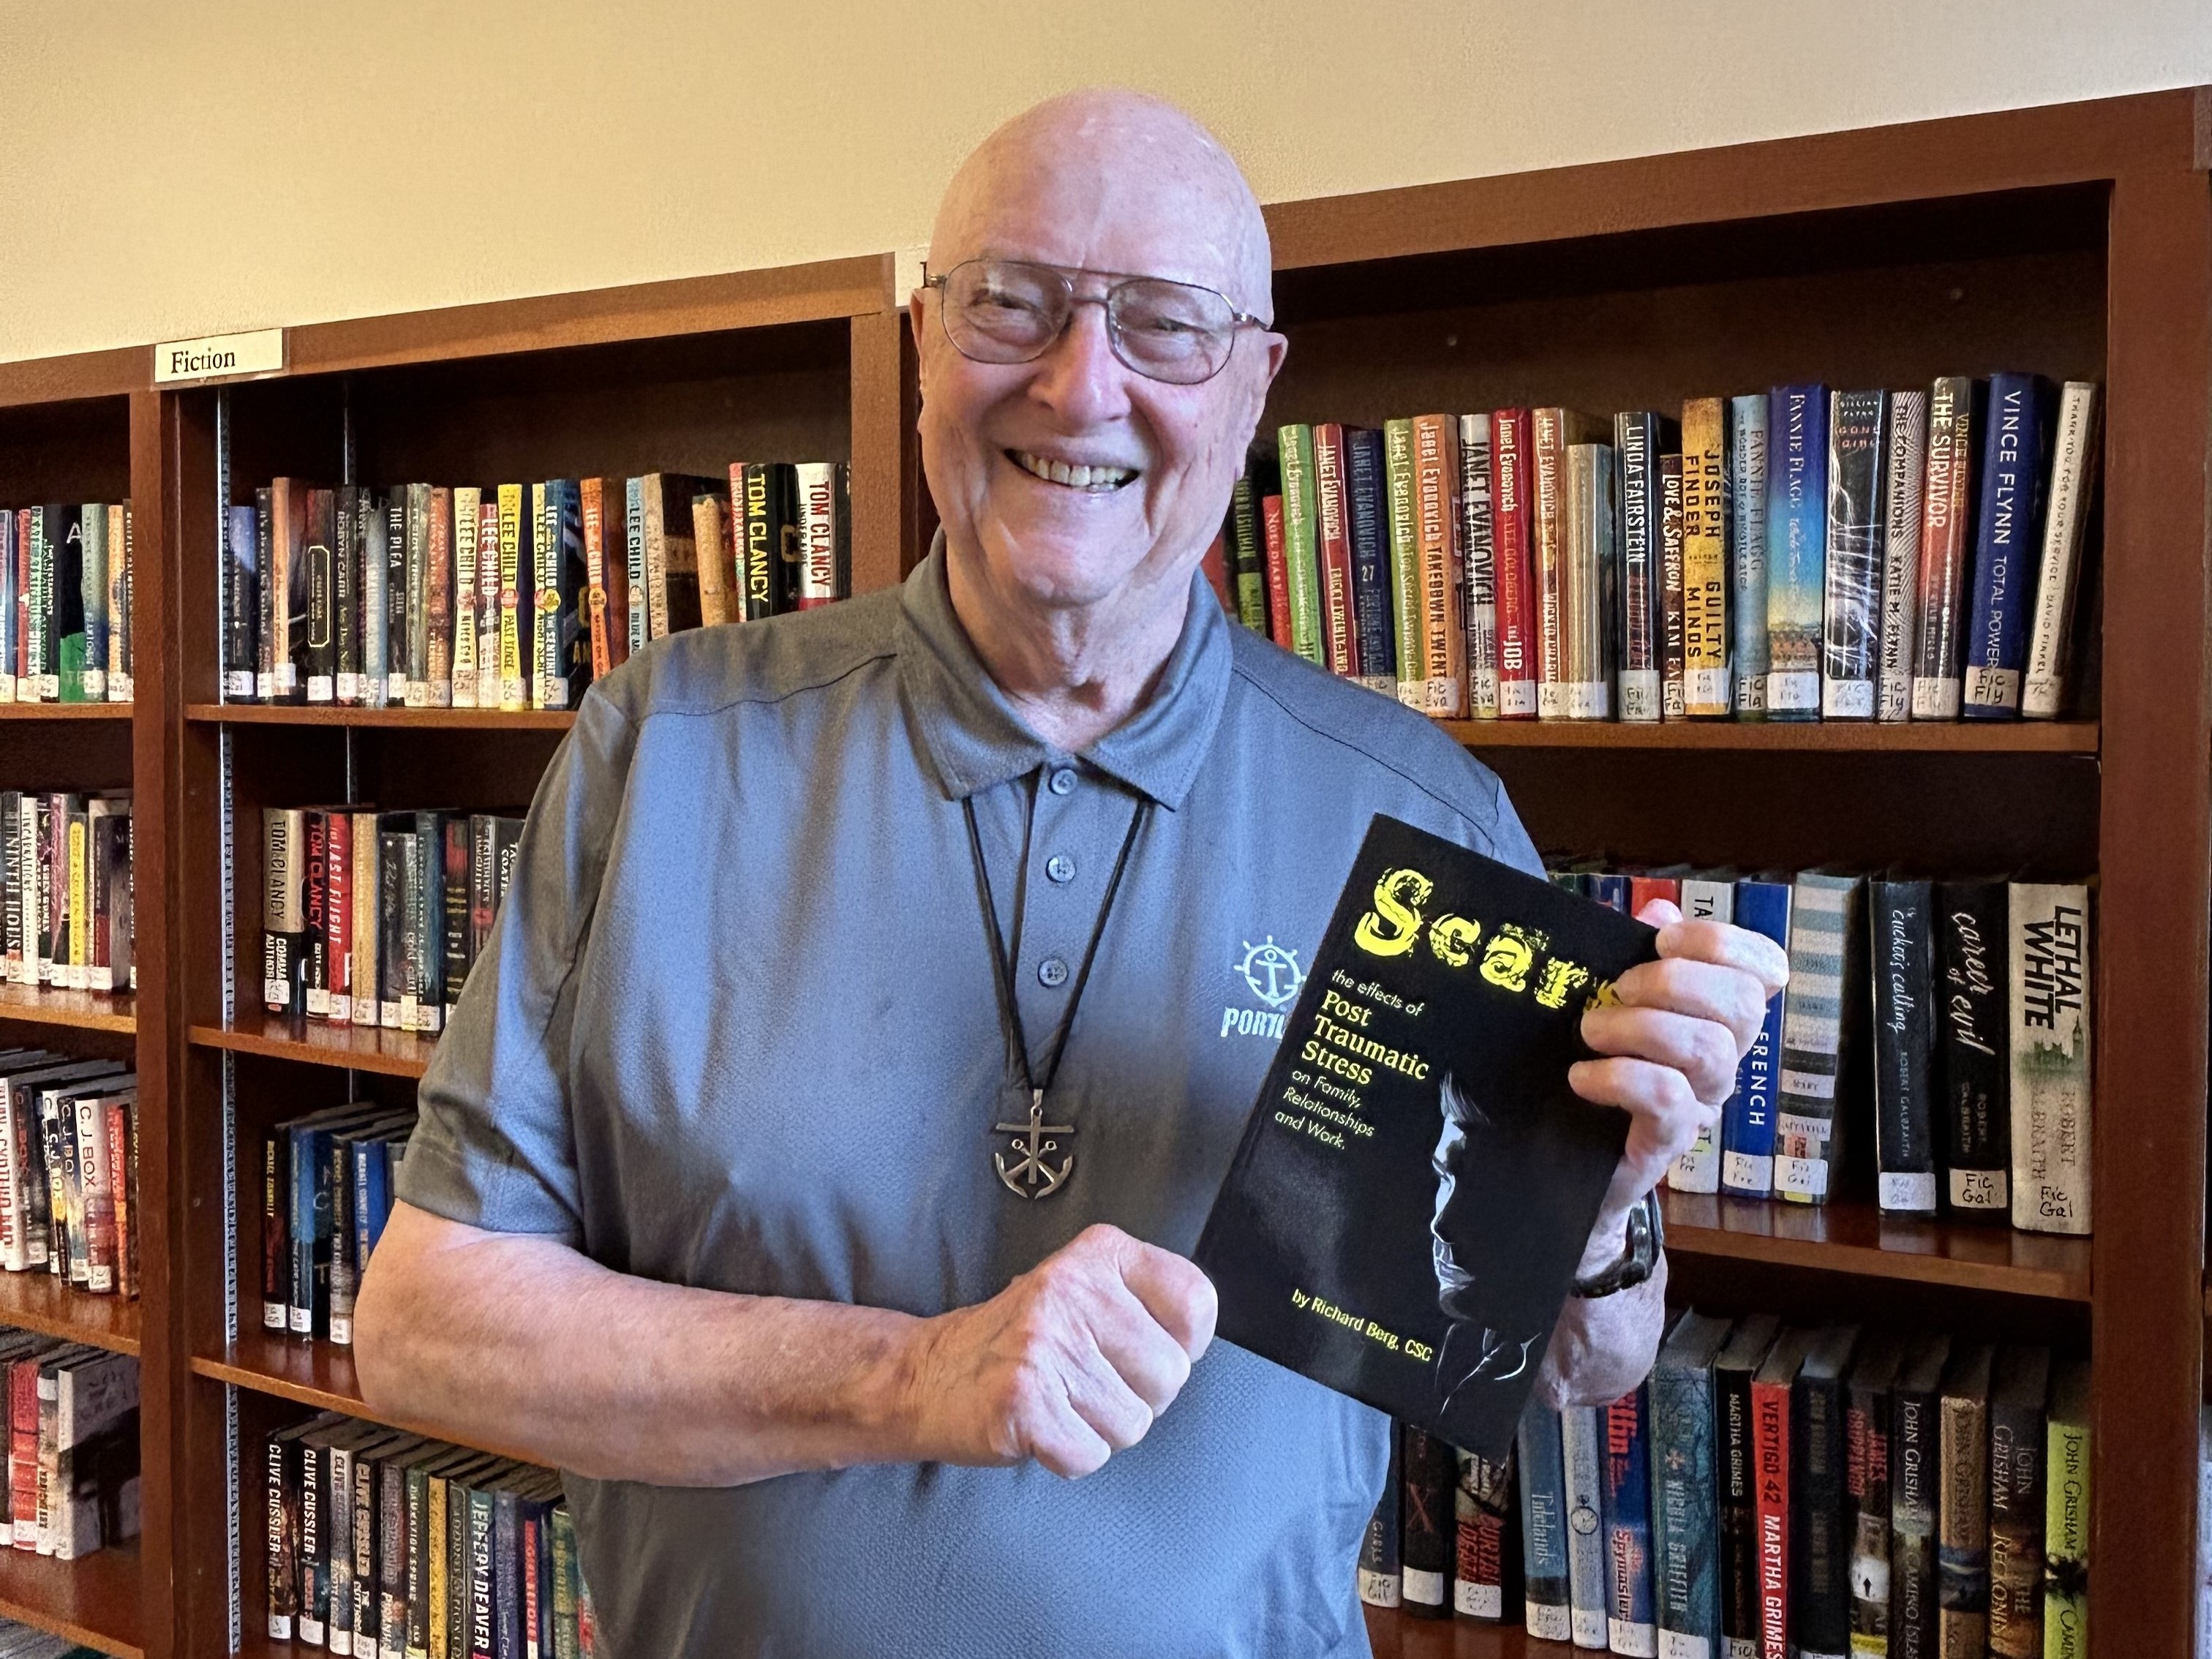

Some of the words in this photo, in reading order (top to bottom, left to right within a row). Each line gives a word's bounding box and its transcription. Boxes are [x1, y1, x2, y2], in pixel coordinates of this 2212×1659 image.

[171, 347, 236, 374] Fiction
[1788, 394, 1806, 451] FANNIE
[1932, 388, 1953, 427] THE
[2000, 391, 2021, 462] VINCE
[1419, 422, 1437, 462] Janet
[1499, 419, 1516, 450] Janet
[1628, 425, 1644, 473] LINDA
[1318, 445, 1336, 478] JANET
[1353, 443, 1372, 481] JANET
[1462, 439, 1491, 494] JANET
[1500, 454, 1518, 512] Evanovich
[1749, 429, 1764, 500] FANNIE
[1788, 456, 1805, 509] FLAGG
[1927, 435, 1950, 527] SURVIVOR
[2060, 469, 2073, 492] FOR
[748, 473, 766, 517] TOM
[809, 481, 830, 515] TOM
[1422, 468, 1442, 542] Evanovich
[1663, 474, 1682, 505] LOVE
[1685, 456, 1701, 537] FINDER
[1704, 449, 1721, 538] JOSEPH
[1891, 436, 1908, 538] COMPANIONS
[1993, 473, 2015, 544] FLYNN
[389, 507, 402, 530] THE
[459, 519, 475, 543] LEE
[481, 519, 497, 544] LEE
[502, 513, 515, 538] LEE
[546, 505, 557, 525] LEE
[585, 508, 598, 529] LEE
[629, 507, 641, 533] LEE
[1320, 480, 1341, 541] EVANOVICH
[1355, 487, 1376, 559] EVANOVICH
[1627, 480, 1645, 563] FAIRSTEIN
[1663, 506, 1682, 522] &
[2055, 497, 2068, 527] YOUR
[337, 511, 345, 557] ROBYN
[389, 537, 402, 568] PLEA
[810, 523, 831, 587] CLANCY
[1464, 500, 1495, 606] EVANOVICH
[459, 546, 475, 584] CHILD
[481, 551, 497, 596] CHILD
[502, 542, 516, 582] CHILD
[545, 551, 557, 587] CHILD
[587, 551, 602, 585] CHILD
[629, 537, 641, 580] CHILD
[749, 522, 768, 603] CLANCY
[1362, 565, 1374, 583] 27
[1664, 525, 1682, 591] SAFFRON
[1888, 556, 1902, 596] KATIE
[2049, 532, 2064, 582] SERVICE
[338, 562, 346, 598] CARR
[1427, 546, 1446, 623] TAKEDOWN
[1990, 556, 2007, 605] TOTAL
[504, 615, 514, 639] PAST
[1667, 611, 1680, 647] KIM
[1687, 587, 1701, 658] MINDS
[1705, 582, 1722, 659] GUILTY
[2042, 594, 2056, 628] DAVID
[1430, 629, 1447, 679] TWENT
[1503, 641, 1523, 669] JOB
[1987, 610, 2003, 668] POWER
[271, 820, 286, 851] TOM
[310, 824, 323, 856] TOM
[6, 838, 20, 893] NINTH
[329, 843, 342, 882] LAST
[271, 859, 285, 919] CLANCY
[309, 862, 323, 930] CLANCY
[6, 901, 20, 948] HOUS
[329, 888, 342, 945] FLIGHT
[1889, 909, 1914, 967] cuckoo's
[276, 938, 287, 979] COMMA
[1354, 868, 1606, 1012] Scar
[1950, 912, 1994, 995] career
[2054, 906, 2082, 1014] LETHAL
[1332, 969, 1355, 988] the
[1357, 982, 1402, 1009] effects
[1405, 1002, 1425, 1016] of
[1946, 967, 1965, 985] of
[2023, 920, 2055, 1030] WHITE
[1220, 1007, 1285, 1039] PORTL
[1321, 989, 1373, 1027] Post
[1886, 974, 1915, 1034] calling
[1949, 995, 1996, 1056] evil
[1301, 1040, 1373, 1085] Stress
[1314, 1015, 1429, 1080] Traumatic
[1292, 1070, 1310, 1085] on
[1314, 1076, 1361, 1108] Family,
[1749, 1031, 1769, 1126] FRENCH
[80, 1106, 92, 1124] C.
[1275, 1111, 1306, 1131] and
[1283, 1086, 1375, 1137] Relationships
[48, 1133, 59, 1148] C.
[50, 1150, 61, 1163] J.
[80, 1129, 93, 1143] J.
[63, 1145, 75, 1175] BO
[82, 1147, 96, 1188] BOX
[1965, 1173, 1994, 1189] Fic
[50, 1167, 64, 1200] BOX
[1962, 1189, 1991, 1204] Gal
[2041, 1185, 2068, 1202] Fic
[2039, 1200, 2072, 1218] Gal
[1292, 1288, 1310, 1309] by
[1312, 1297, 1365, 1331] Richard
[1366, 1322, 1399, 1350] Berg,
[1404, 1339, 1433, 1362] CSC
[1729, 1393, 1742, 1445] MARTHA
[1762, 1401, 1780, 1475] VERTIGO
[1903, 1401, 1920, 1442] JOHN
[268, 1444, 282, 1486] CLIVE
[304, 1449, 316, 1490] CLIVE
[1730, 1448, 1742, 1497] GRIMES
[1993, 1425, 2013, 1510] GRISHAM
[2017, 1448, 2038, 1494] JOHN
[2064, 1434, 2083, 1475] JOHN
[1764, 1478, 1781, 1504] 42
[1905, 1449, 1920, 1521] GRISHAM
[269, 1489, 282, 1552] CUSSLER
[304, 1491, 316, 1554] CUSSLER
[471, 1499, 490, 1577] JEFFERY
[2064, 1480, 2082, 1551] GRISHAM
[1764, 1514, 1782, 1590] MARTHA
[1610, 1530, 1631, 1622] Spymaster
[473, 1580, 490, 1649] DEAVER
[1765, 1596, 1784, 1659] GRIMES
